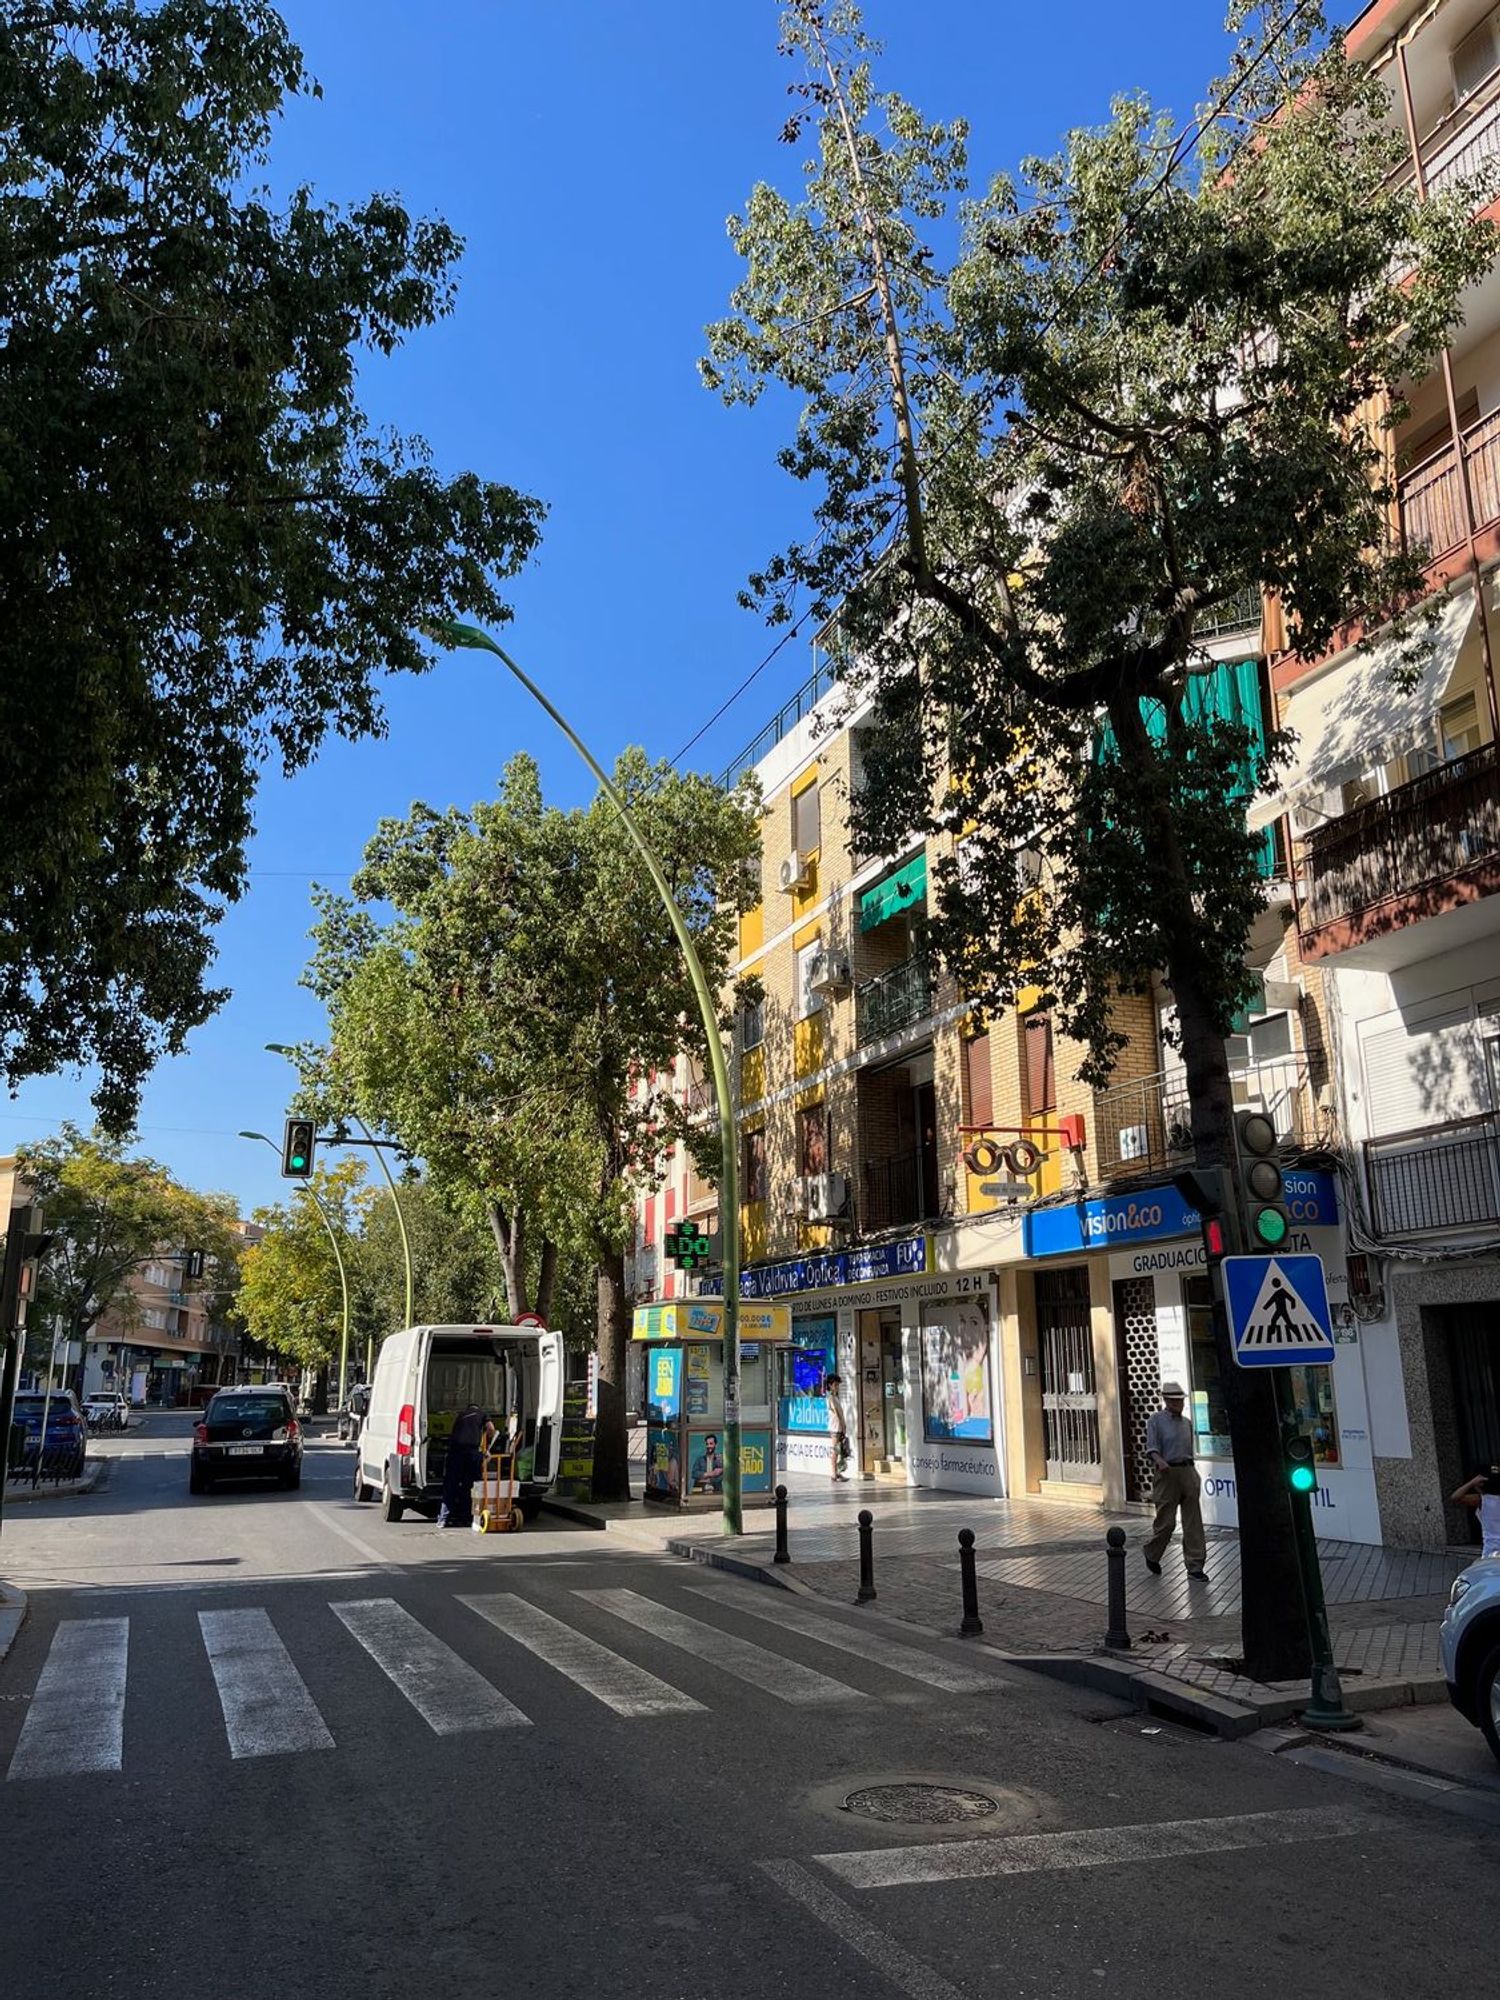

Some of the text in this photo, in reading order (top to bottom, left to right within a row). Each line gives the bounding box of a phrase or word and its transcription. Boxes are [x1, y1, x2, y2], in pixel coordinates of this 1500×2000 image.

[1285, 1176, 1317, 1195] sion
[1080, 1203, 1162, 1237] vision&co
[758, 1266, 799, 1293] Valdivia
[804, 1301, 812, 1312] DE
[812, 1297, 832, 1311] LUNES
[839, 1292, 872, 1307] DOMINGO
[876, 1286, 909, 1302] FESTIVOS
[910, 1281, 948, 1298] INCLUIDO
[956, 1278, 970, 1293] 12
[973, 1276, 983, 1291] H
[940, 1453, 995, 1476] farmacéutico
